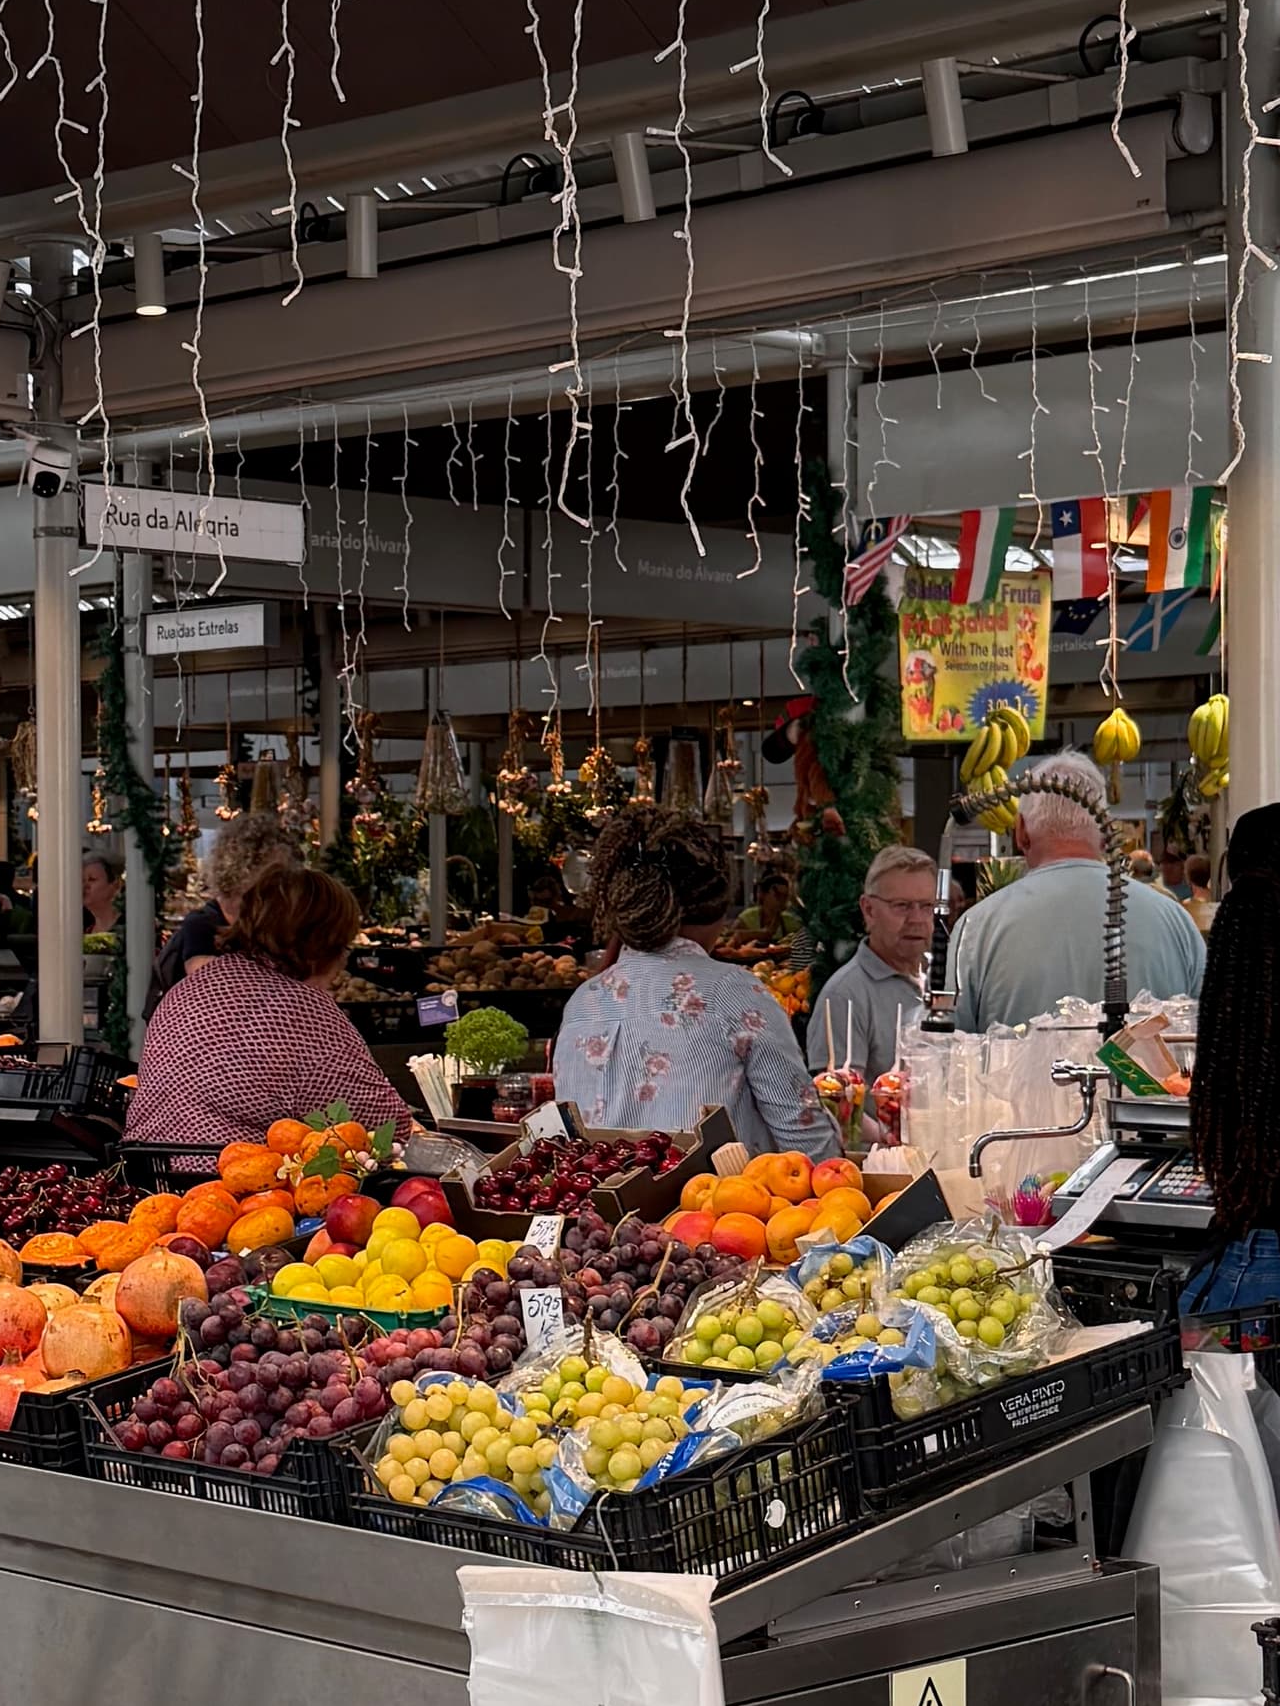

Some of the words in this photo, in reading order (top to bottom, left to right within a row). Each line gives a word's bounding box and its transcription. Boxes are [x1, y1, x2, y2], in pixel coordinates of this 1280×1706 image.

[106, 503, 141, 528] Rua
[146, 507, 169, 530] da
[311, 530, 338, 548] aria
[637, 558, 673, 578] Maria
[676, 564, 692, 581] do
[695, 559, 734, 584] Álvaro
[1001, 583, 1042, 605] Fruta
[157, 625, 176, 641] Rua
[178, 623, 196, 639] das
[198, 618, 239, 637] Estrelas
[940, 643, 966, 658] With
[970, 643, 989, 657] The
